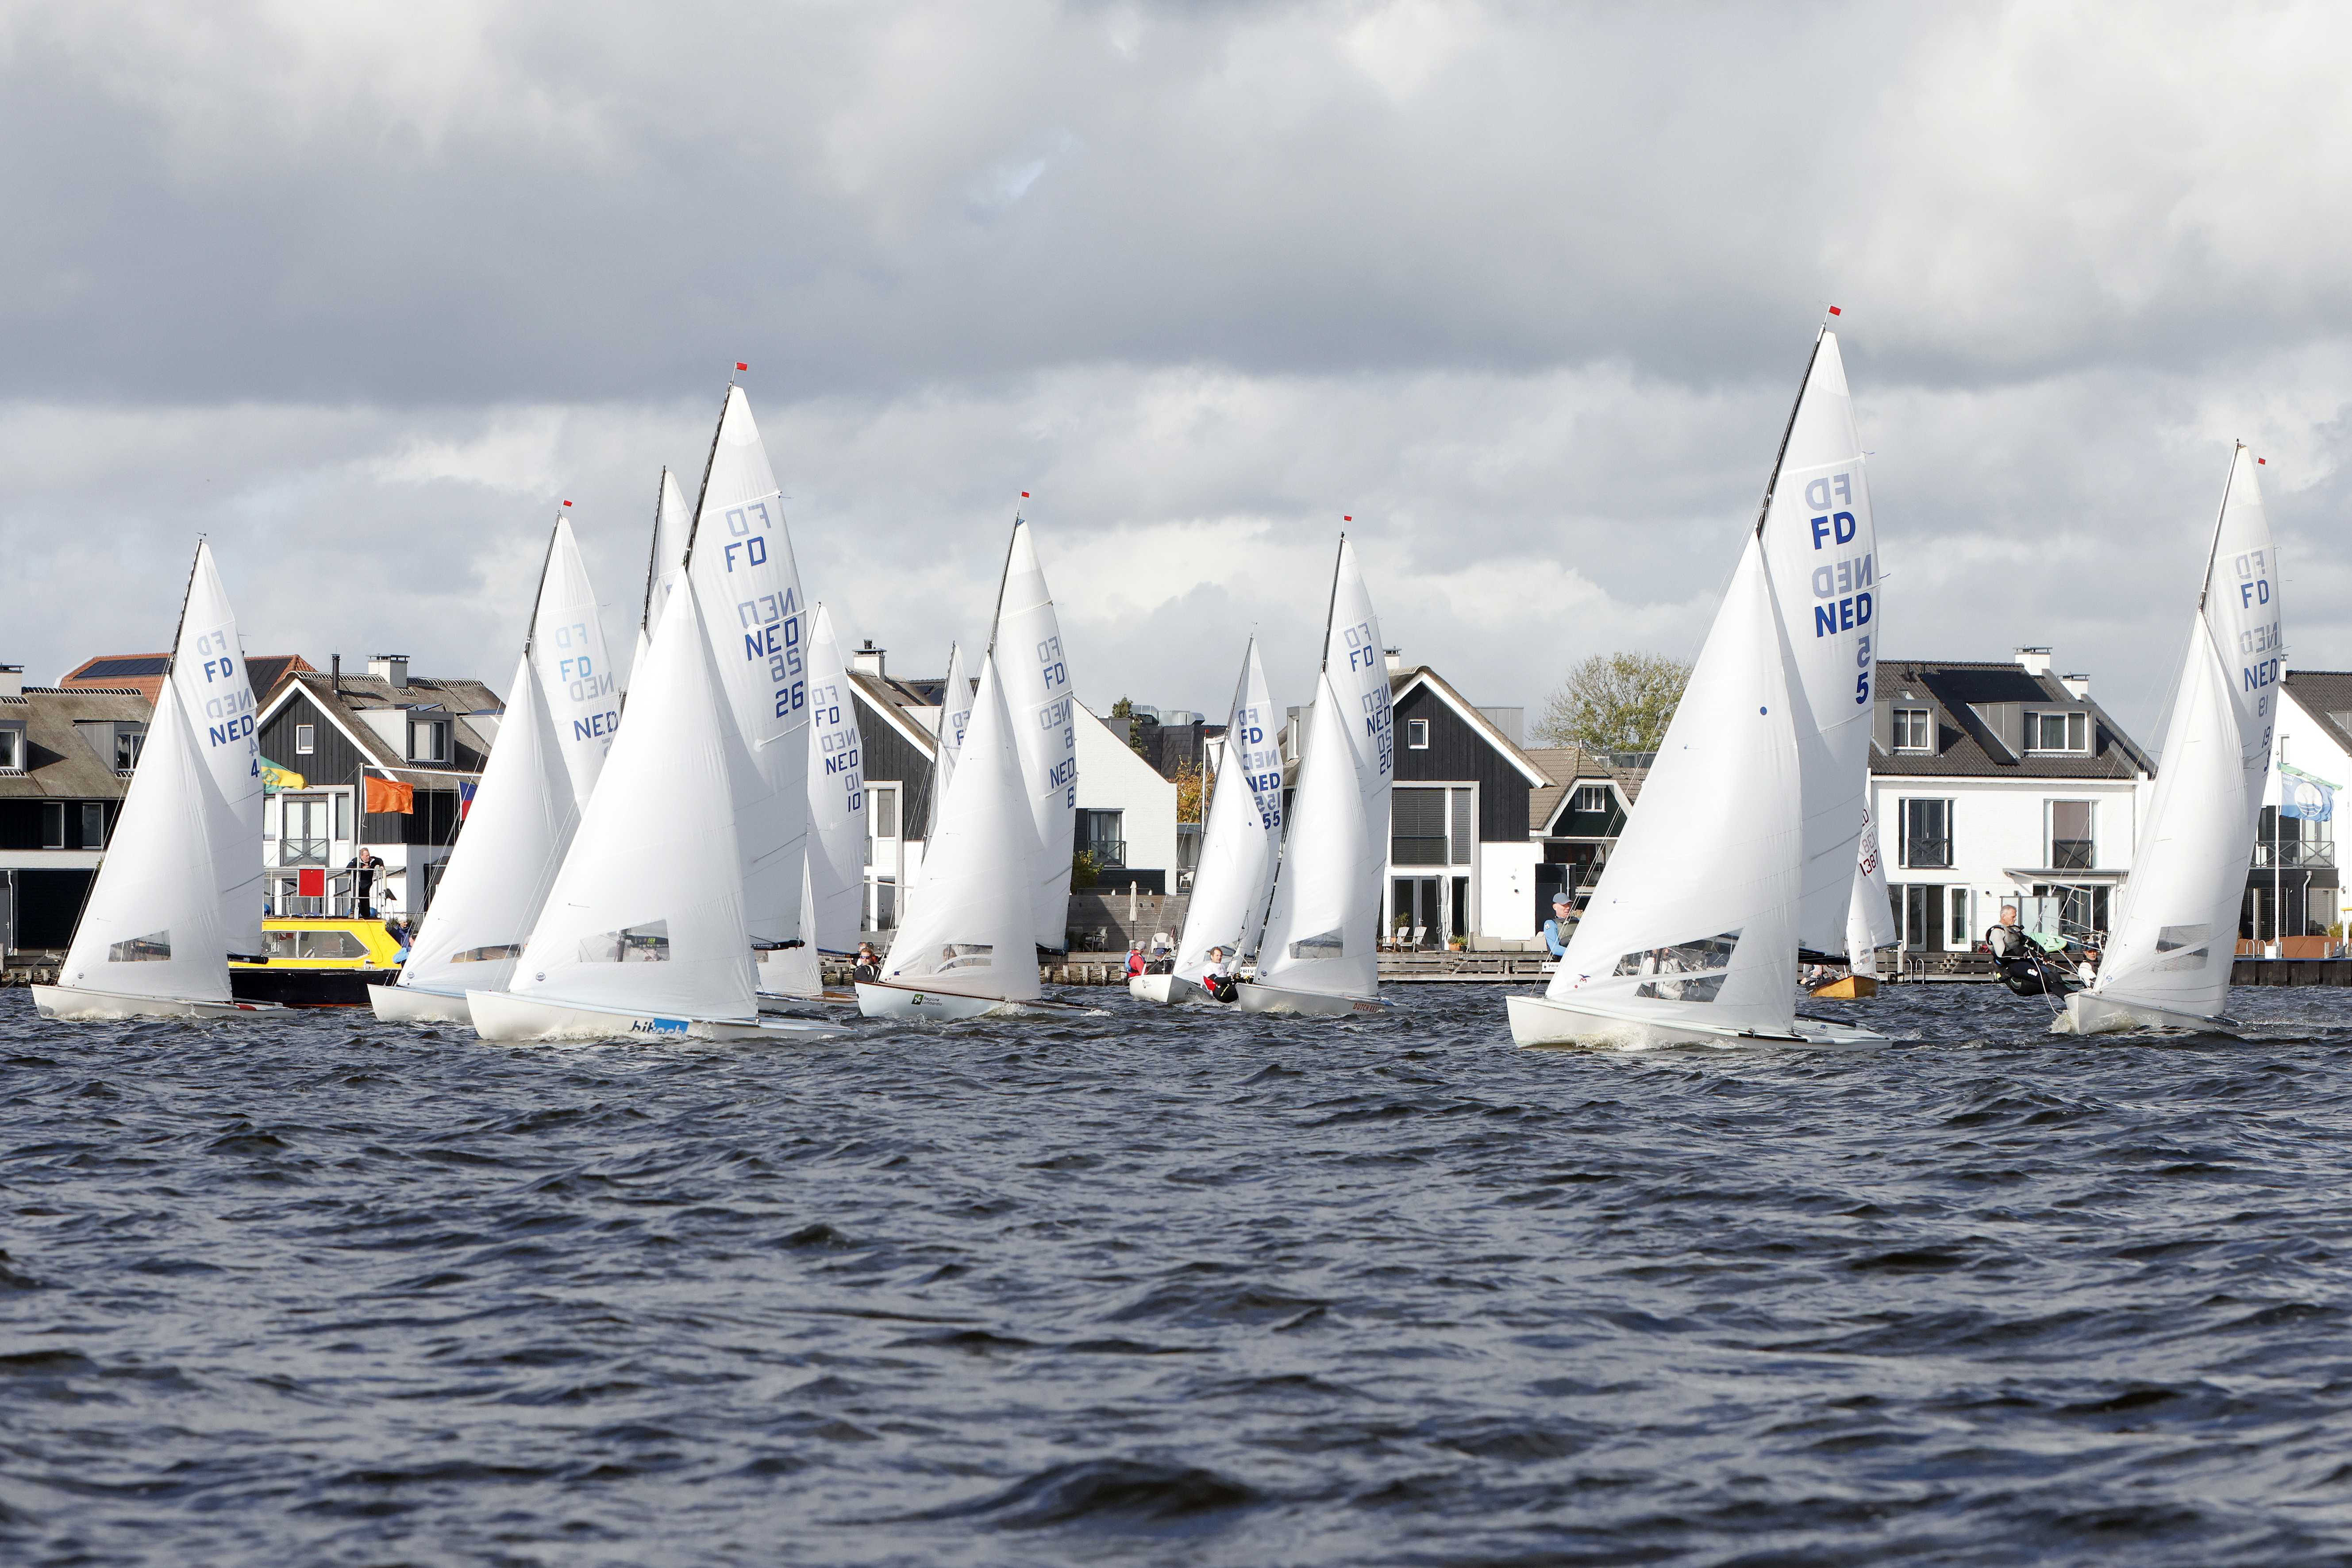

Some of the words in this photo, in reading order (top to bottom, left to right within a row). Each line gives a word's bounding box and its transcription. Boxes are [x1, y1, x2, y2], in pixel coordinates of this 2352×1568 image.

[1810, 512, 1856, 550] FD
[724, 536, 767, 573] FD
[2240, 579, 2269, 609] FD
[1814, 592, 1872, 638] NED
[744, 617, 799, 661] NED
[203, 657, 233, 683] FD
[559, 655, 592, 682] FD
[1349, 644, 1374, 672] FD
[1043, 662, 1065, 690] FD
[1855, 671, 1868, 705] 5
[2244, 658, 2277, 692] NED
[775, 680, 804, 719] 26
[209, 714, 254, 747] NED
[574, 711, 619, 741] NED
[815, 706, 840, 727] FD
[1366, 704, 1391, 737] NED
[956, 729, 966, 746] F
[1241, 727, 1263, 746] FD
[250, 758, 260, 778] 4
[825, 749, 858, 775] NED
[1050, 756, 1075, 789] NED
[1380, 747, 1392, 776] 20
[1067, 786, 1074, 809] 6
[1245, 773, 1280, 793] NED
[848, 792, 861, 813] 10
[1859, 848, 1879, 877] 1387
[1353, 1003, 1370, 1011] DUTCH
